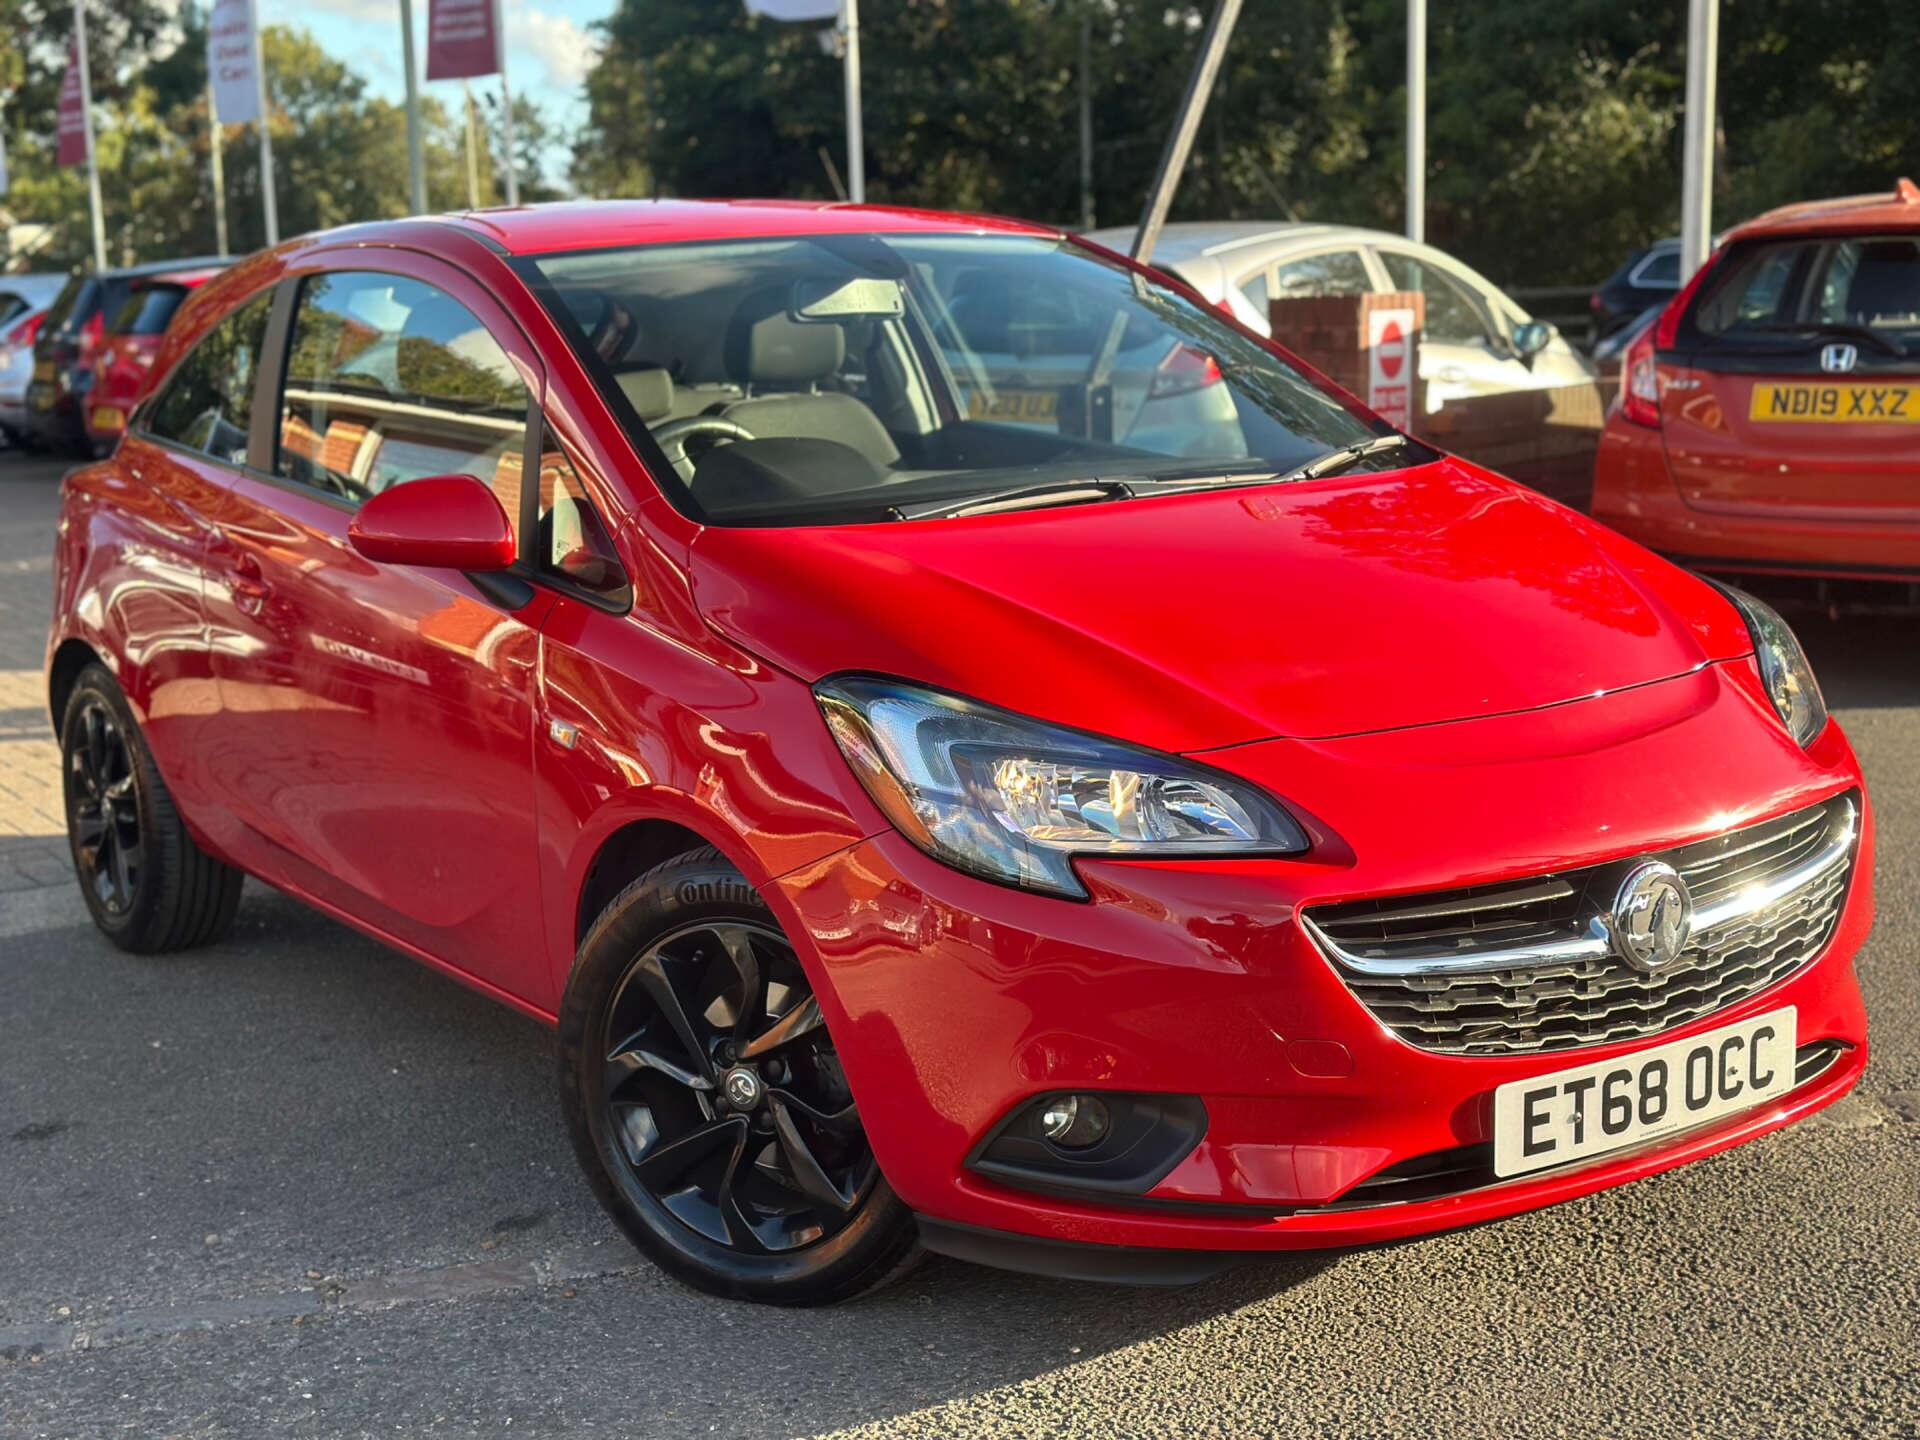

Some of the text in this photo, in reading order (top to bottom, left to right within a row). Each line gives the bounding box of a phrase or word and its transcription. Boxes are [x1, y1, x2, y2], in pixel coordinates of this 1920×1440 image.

[1771, 387, 1909, 416] ND19 XXZ
[1523, 1025, 1776, 1157] ET68 OCC
